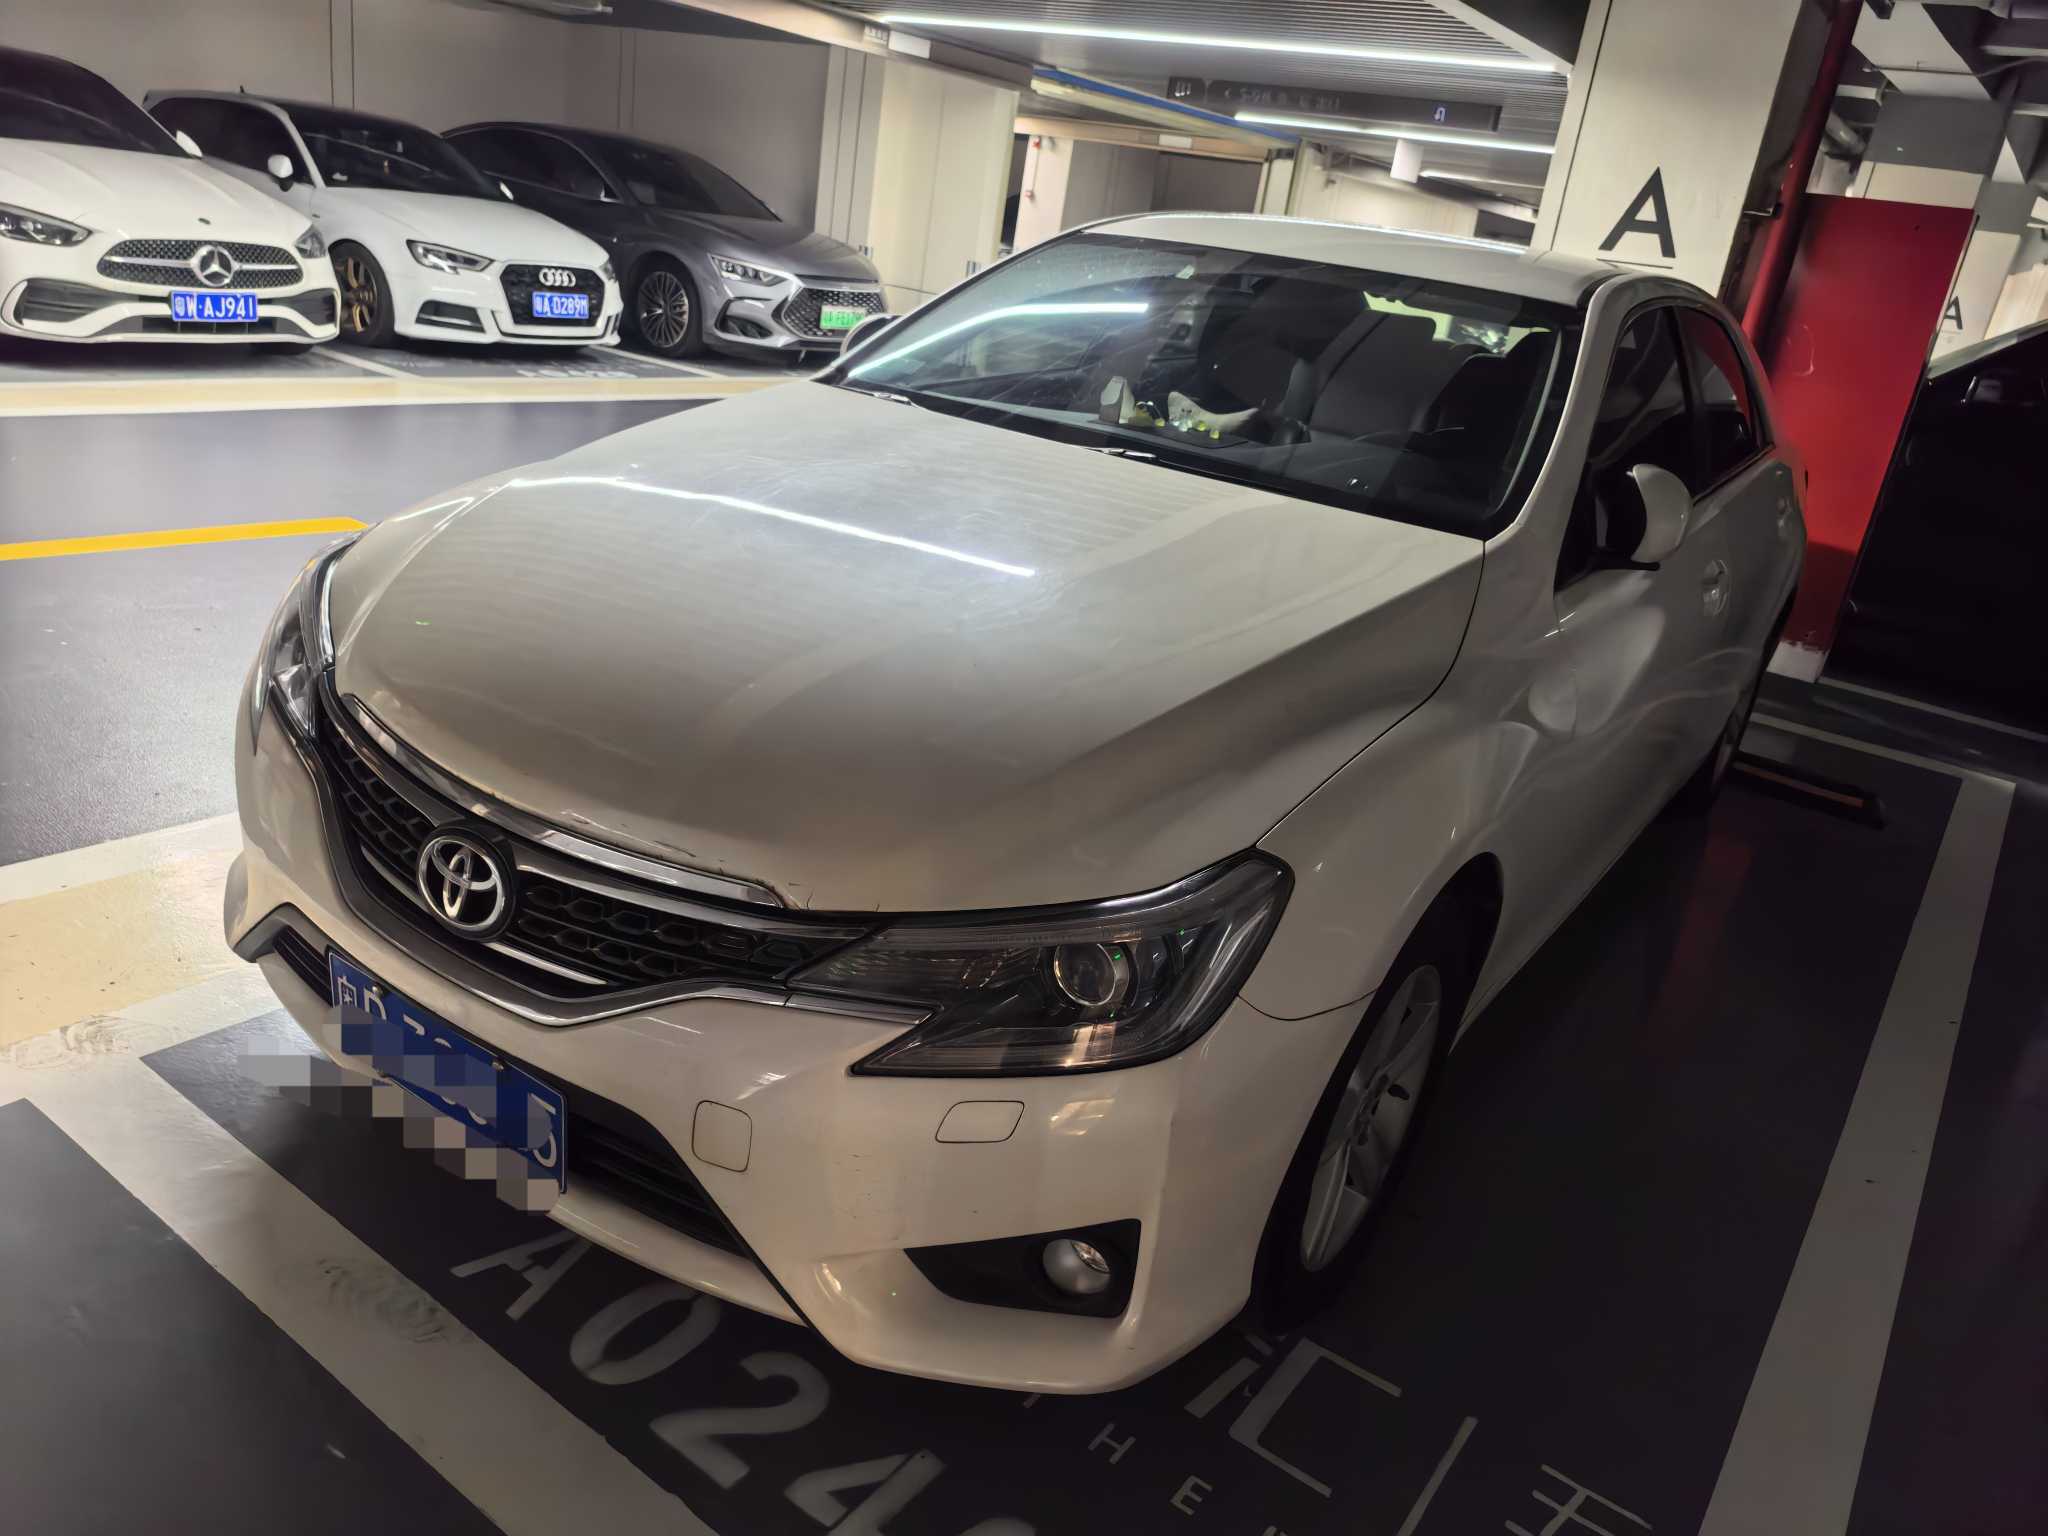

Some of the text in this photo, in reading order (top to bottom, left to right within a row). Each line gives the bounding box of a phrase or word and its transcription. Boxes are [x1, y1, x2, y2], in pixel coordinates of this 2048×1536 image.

[1598, 166, 1676, 259] A
[1943, 296, 1963, 330] A
[449, 1228, 1037, 1536] A024
